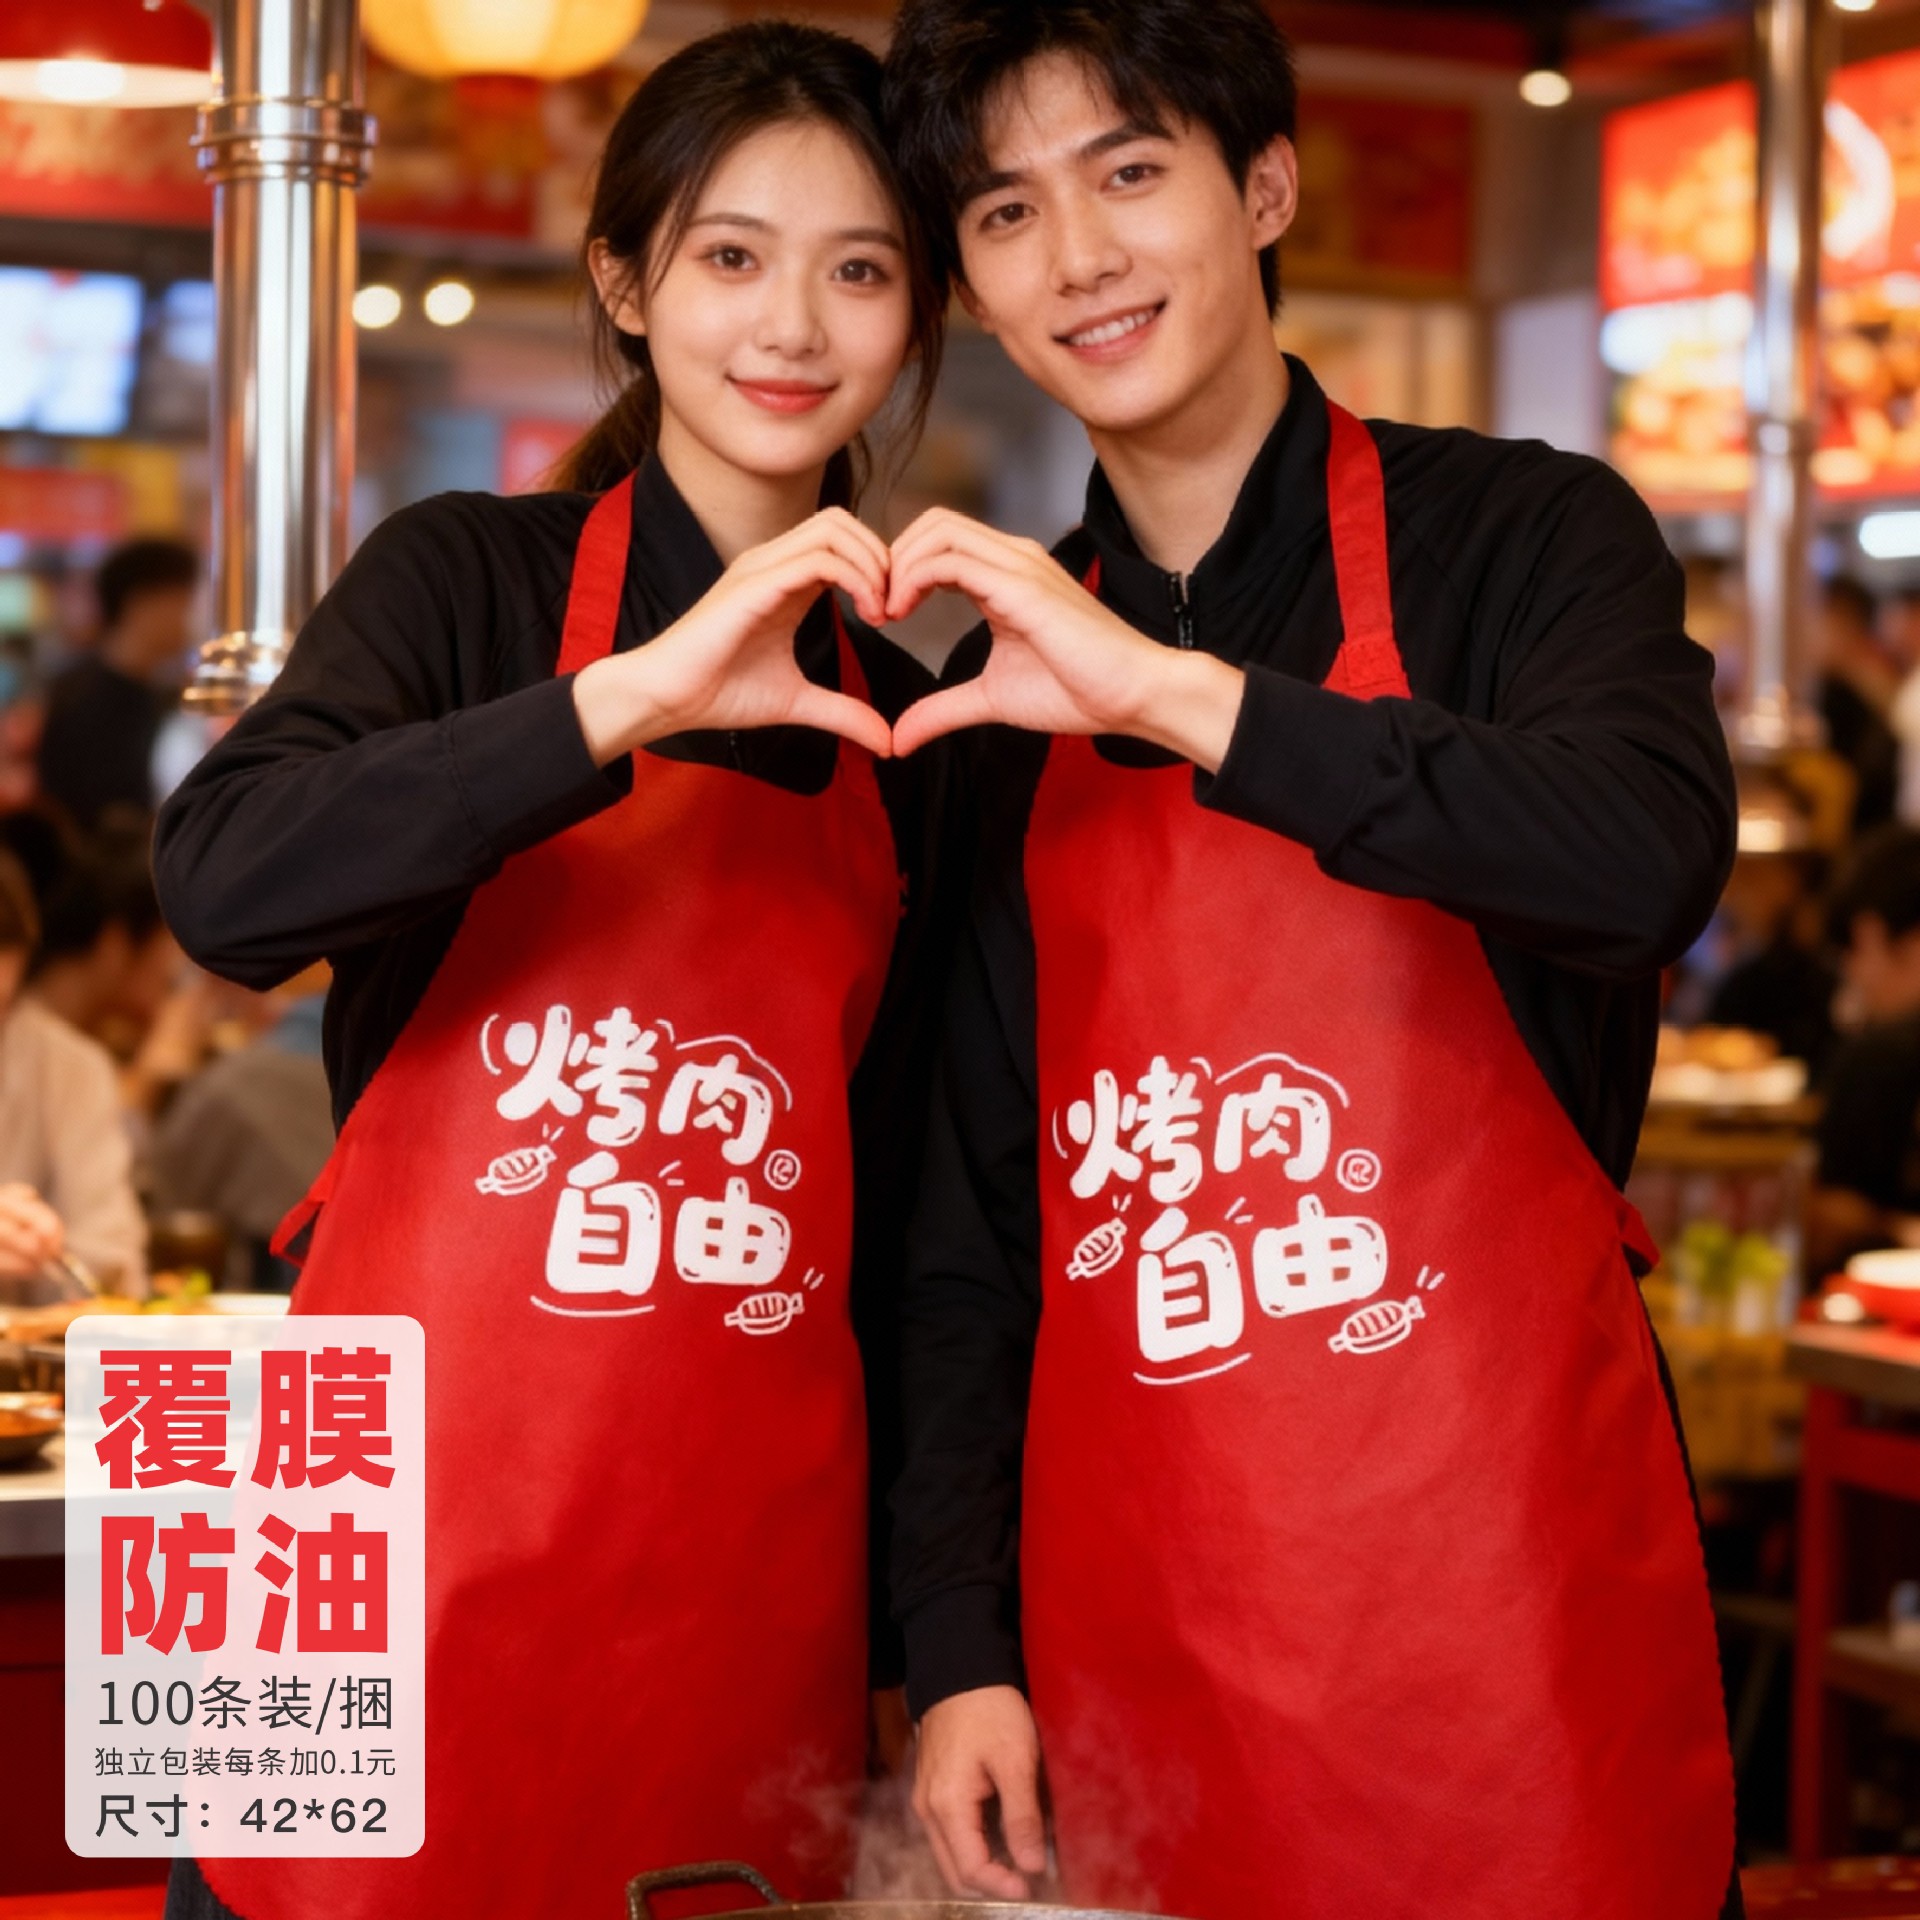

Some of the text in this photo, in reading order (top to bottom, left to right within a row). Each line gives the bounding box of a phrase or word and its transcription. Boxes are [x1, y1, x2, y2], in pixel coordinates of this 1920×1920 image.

[497, 1004, 773, 1165] 烤肉
[1068, 1055, 1332, 1203] 烤肉
[546, 1150, 792, 1296] 自由
[1137, 1194, 1389, 1362] 自由
